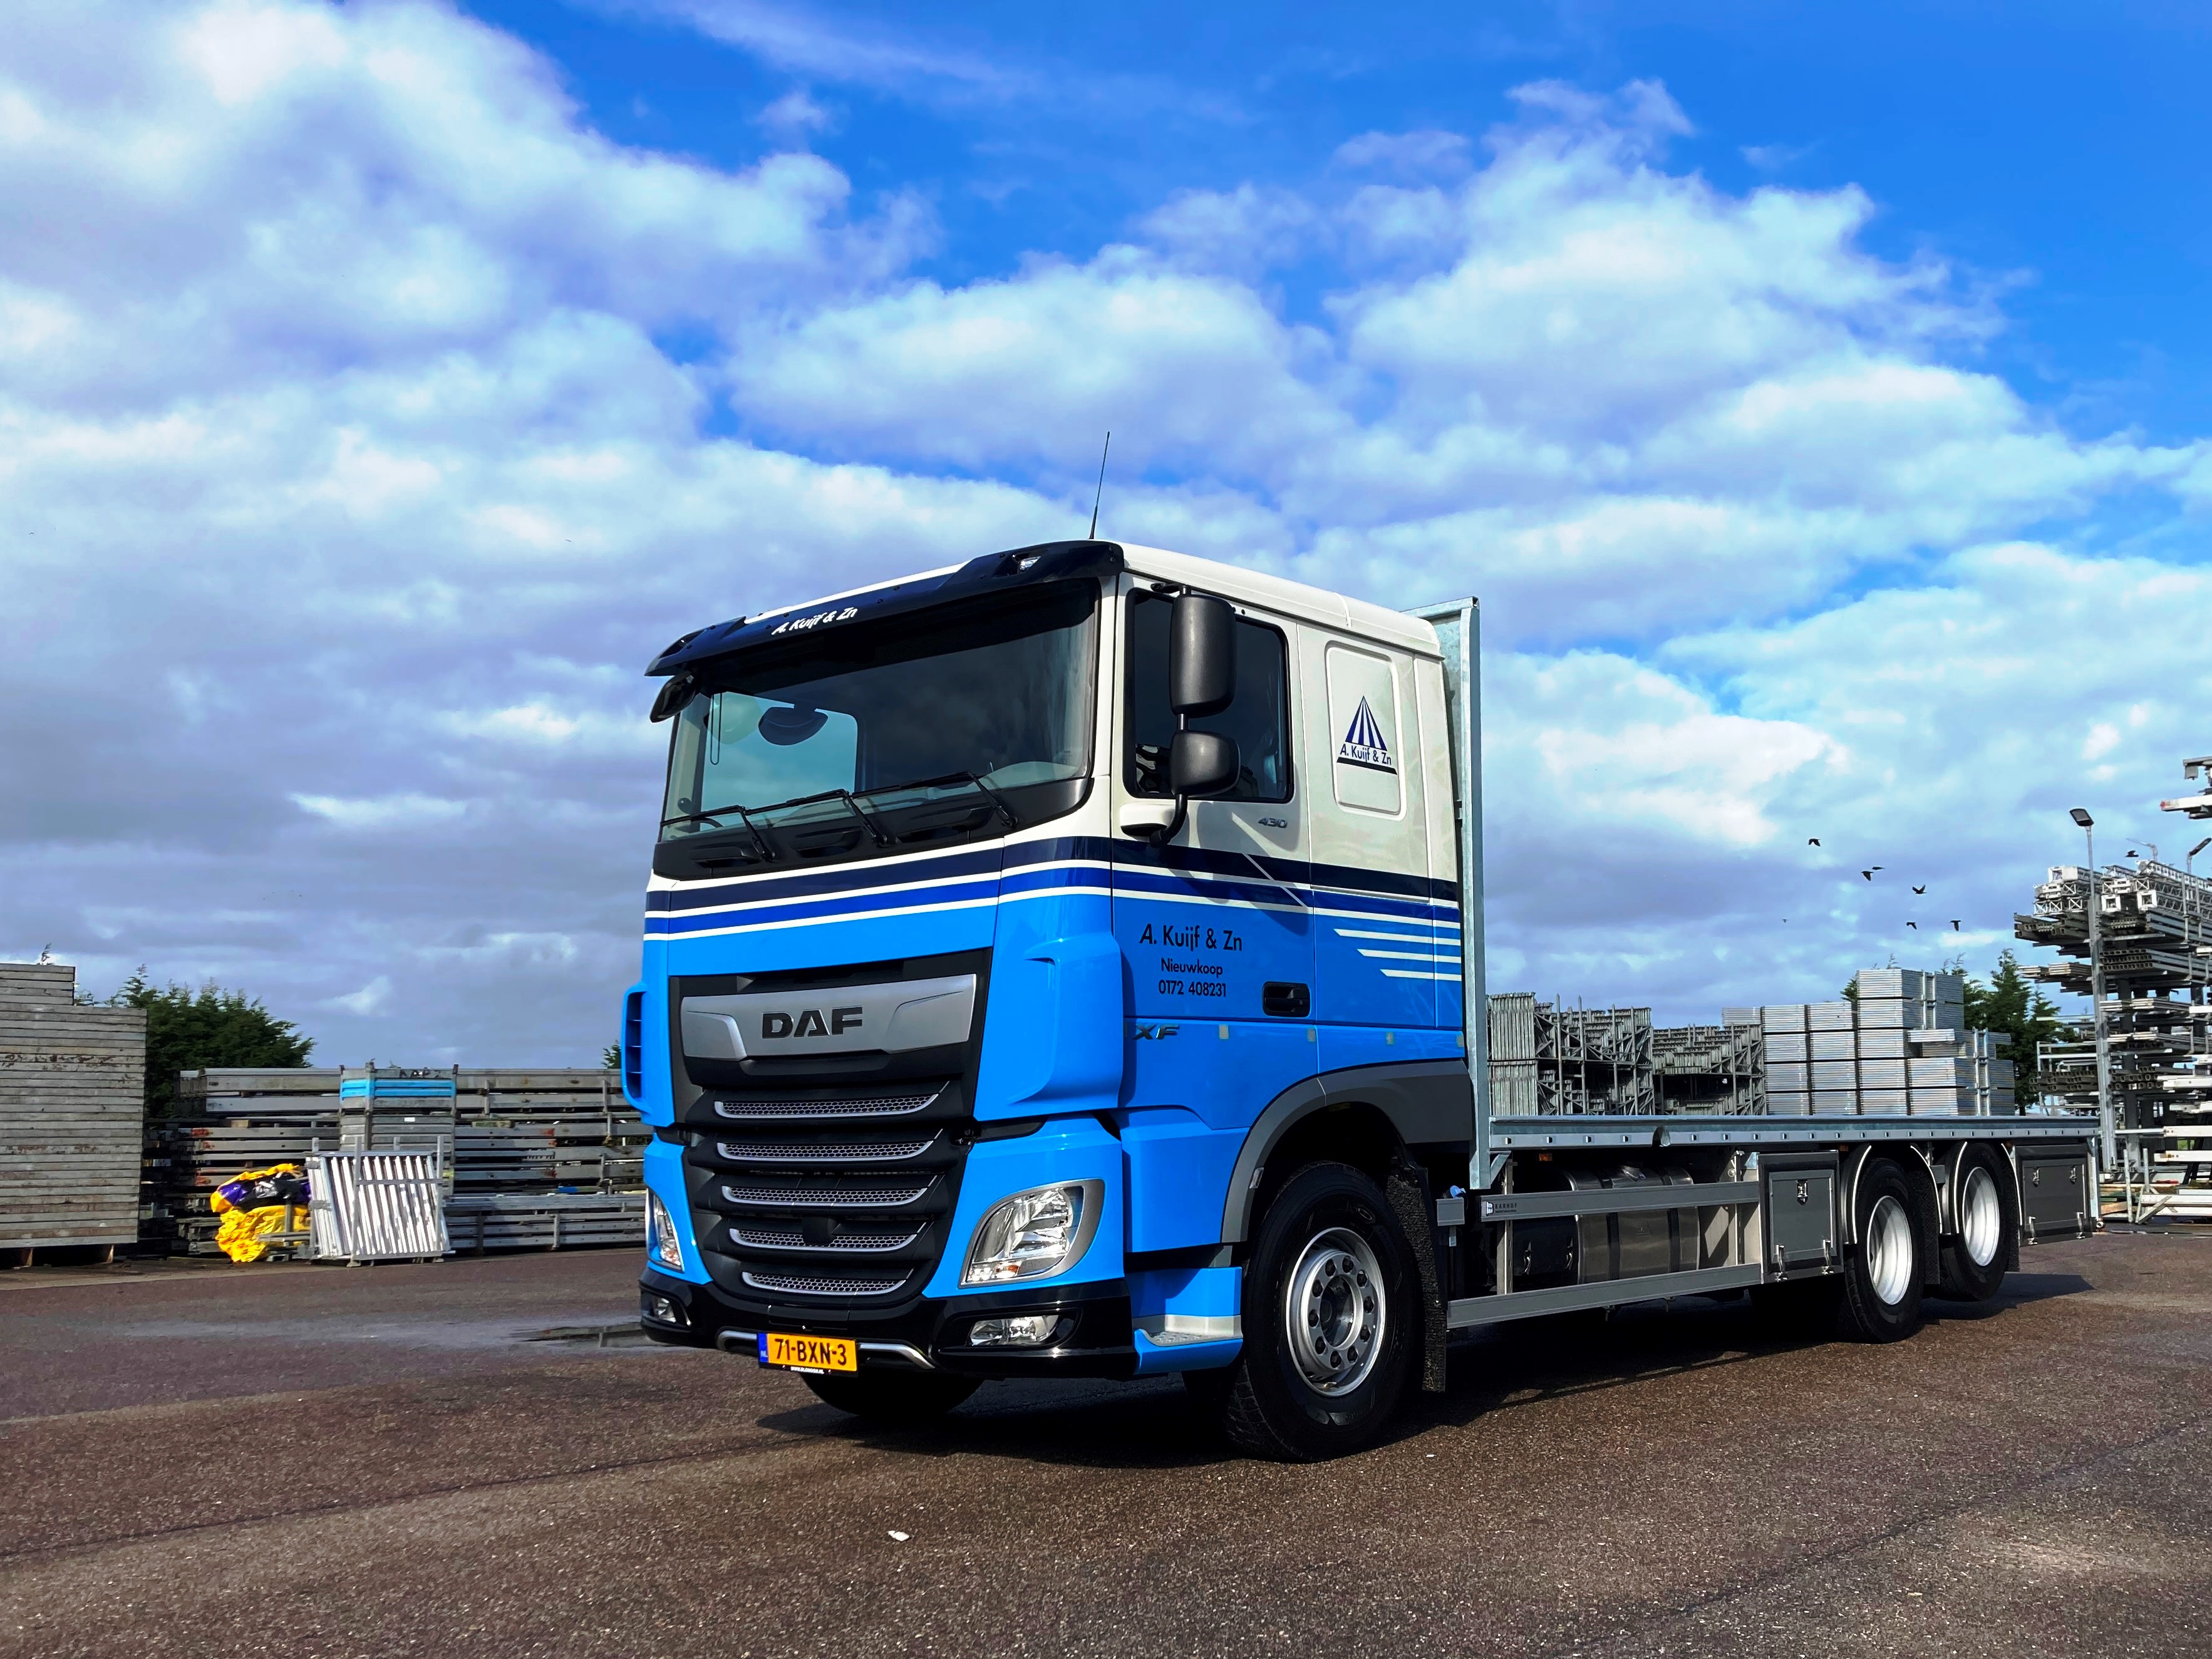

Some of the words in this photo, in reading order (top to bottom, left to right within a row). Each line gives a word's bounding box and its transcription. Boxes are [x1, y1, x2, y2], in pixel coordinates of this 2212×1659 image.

[771, 622, 790, 635] A.
[788, 612, 827, 631] Kuijf
[822, 611, 837, 623] &
[836, 607, 858, 620] Zn
[1340, 743, 1349, 756] A.
[1351, 745, 1370, 763] Kuijf
[1373, 750, 1379, 762] &
[1381, 752, 1392, 765] Zn
[1258, 817, 1288, 828] 430
[1139, 923, 1157, 944] A.
[1163, 924, 1200, 951] Kuijf
[1206, 928, 1217, 949] &
[1223, 930, 1242, 951] Zn
[1161, 957, 1223, 978] Nieuwkoop
[1159, 979, 1184, 995] 0172
[1189, 981, 1226, 997] 408231
[762, 1005, 863, 1038] DAF
[1132, 1023, 1180, 1040] XF
[775, 1338, 847, 1366] 71-BXN-3
